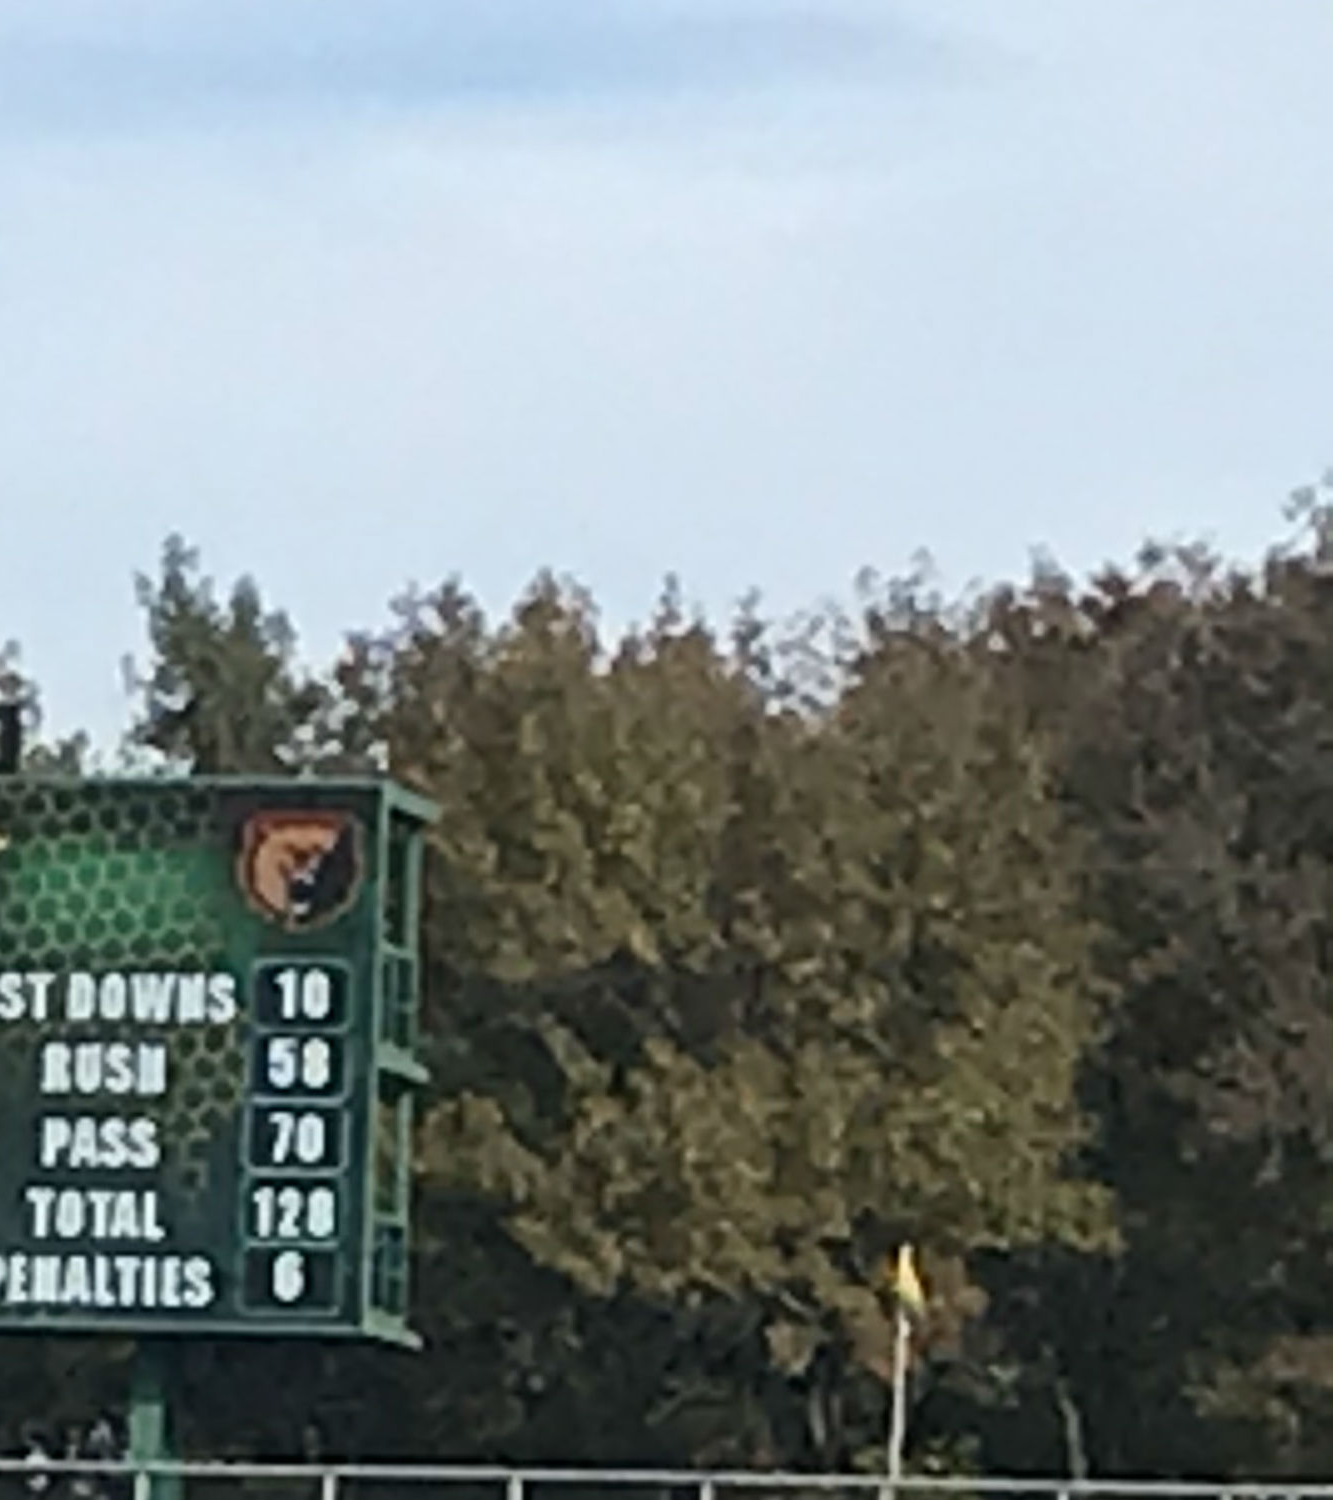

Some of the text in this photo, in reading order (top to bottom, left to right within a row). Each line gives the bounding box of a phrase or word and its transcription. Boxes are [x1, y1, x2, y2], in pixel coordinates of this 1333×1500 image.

[65, 972, 237, 1024] DOWNS
[275, 969, 331, 1021] 10
[40, 1042, 167, 1095] RUSH
[39, 1117, 161, 1168] PASS
[268, 1112, 325, 1163] 70
[26, 1187, 165, 1241] TOTAL
